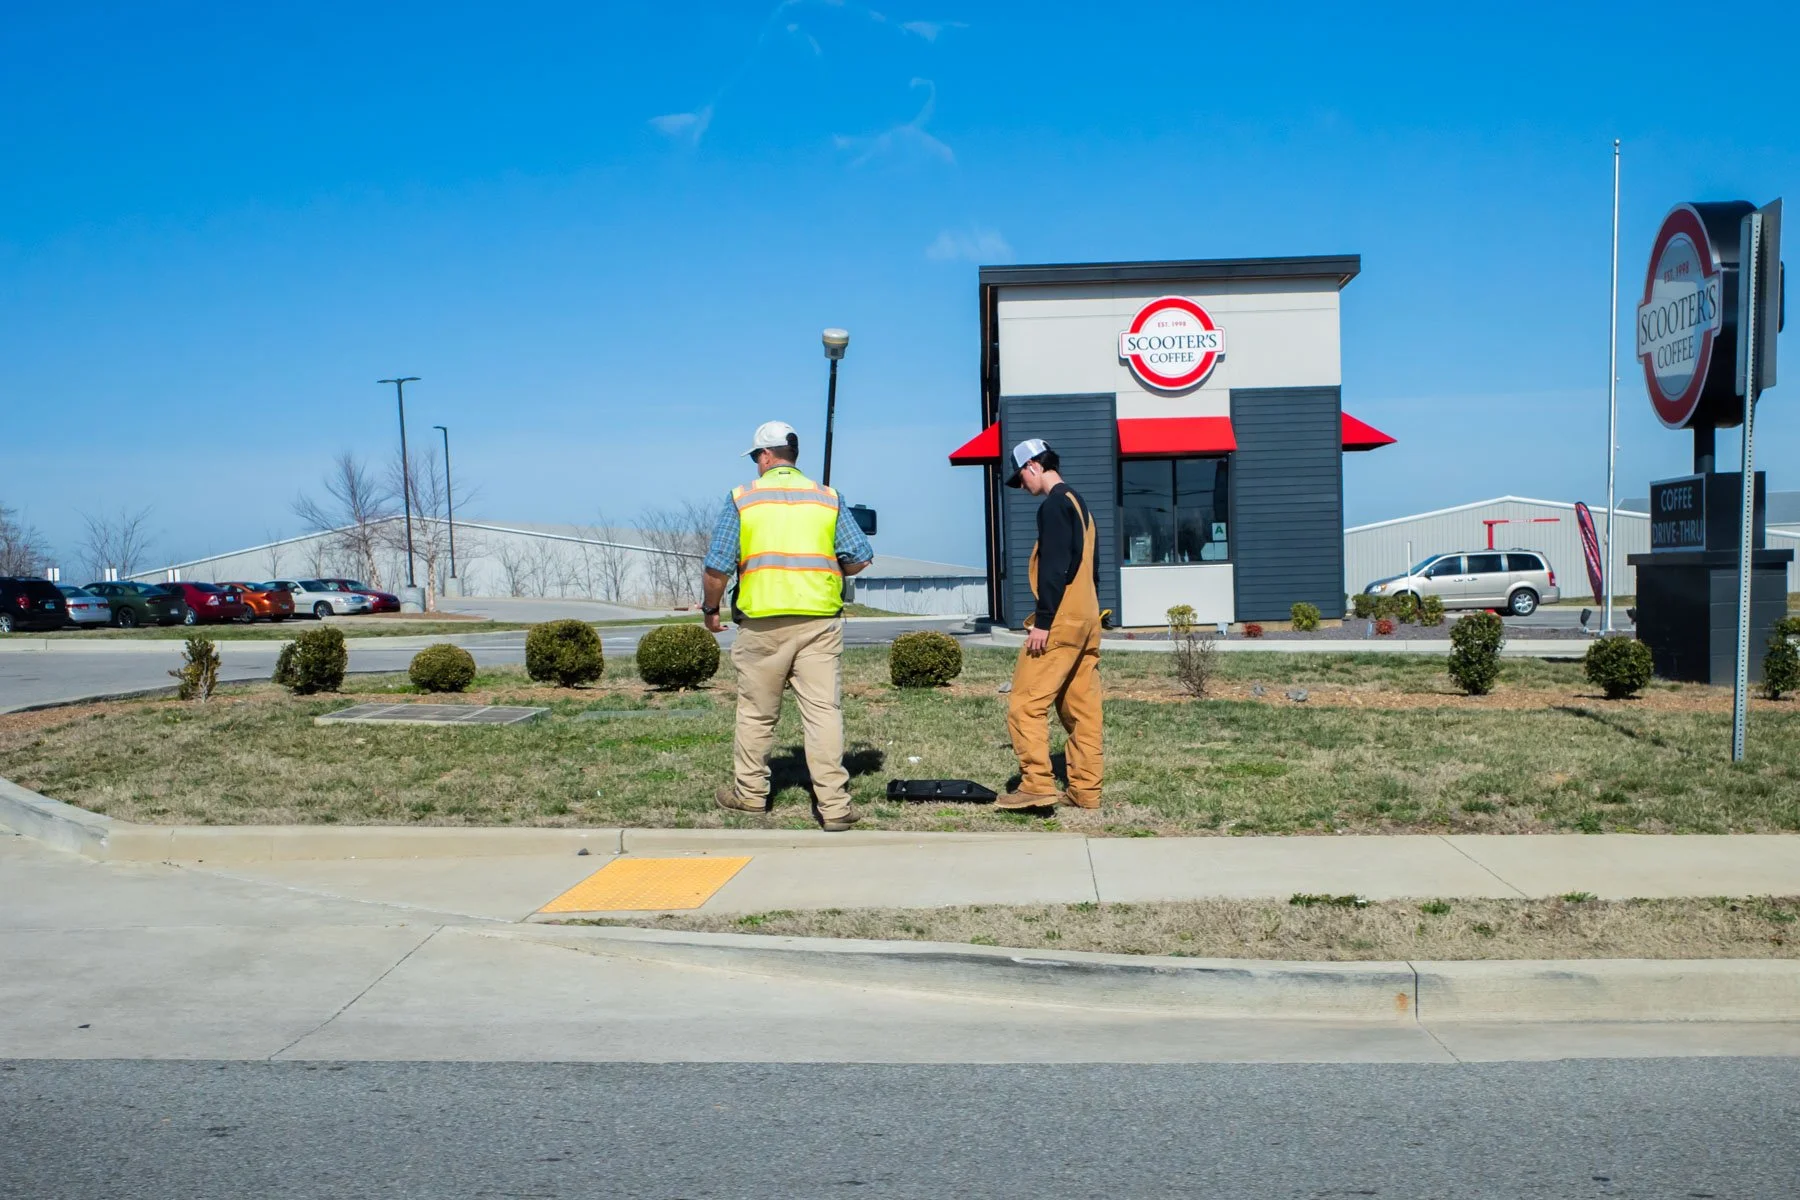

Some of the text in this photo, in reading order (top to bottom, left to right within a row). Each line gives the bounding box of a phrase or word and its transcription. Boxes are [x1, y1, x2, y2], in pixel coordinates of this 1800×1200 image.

[1663, 261, 1690, 284] EST. 1998
[1640, 284, 1717, 346] SCOOTER'S
[1128, 334, 1217, 351] SCOOTER'S
[1657, 335, 1695, 369] COFFEE
[1149, 352, 1194, 363] COFFEE
[1660, 486, 1692, 512] COFFEE
[1215, 526, 1224, 535] A
[1652, 517, 1703, 544] DRIVE-THRU
